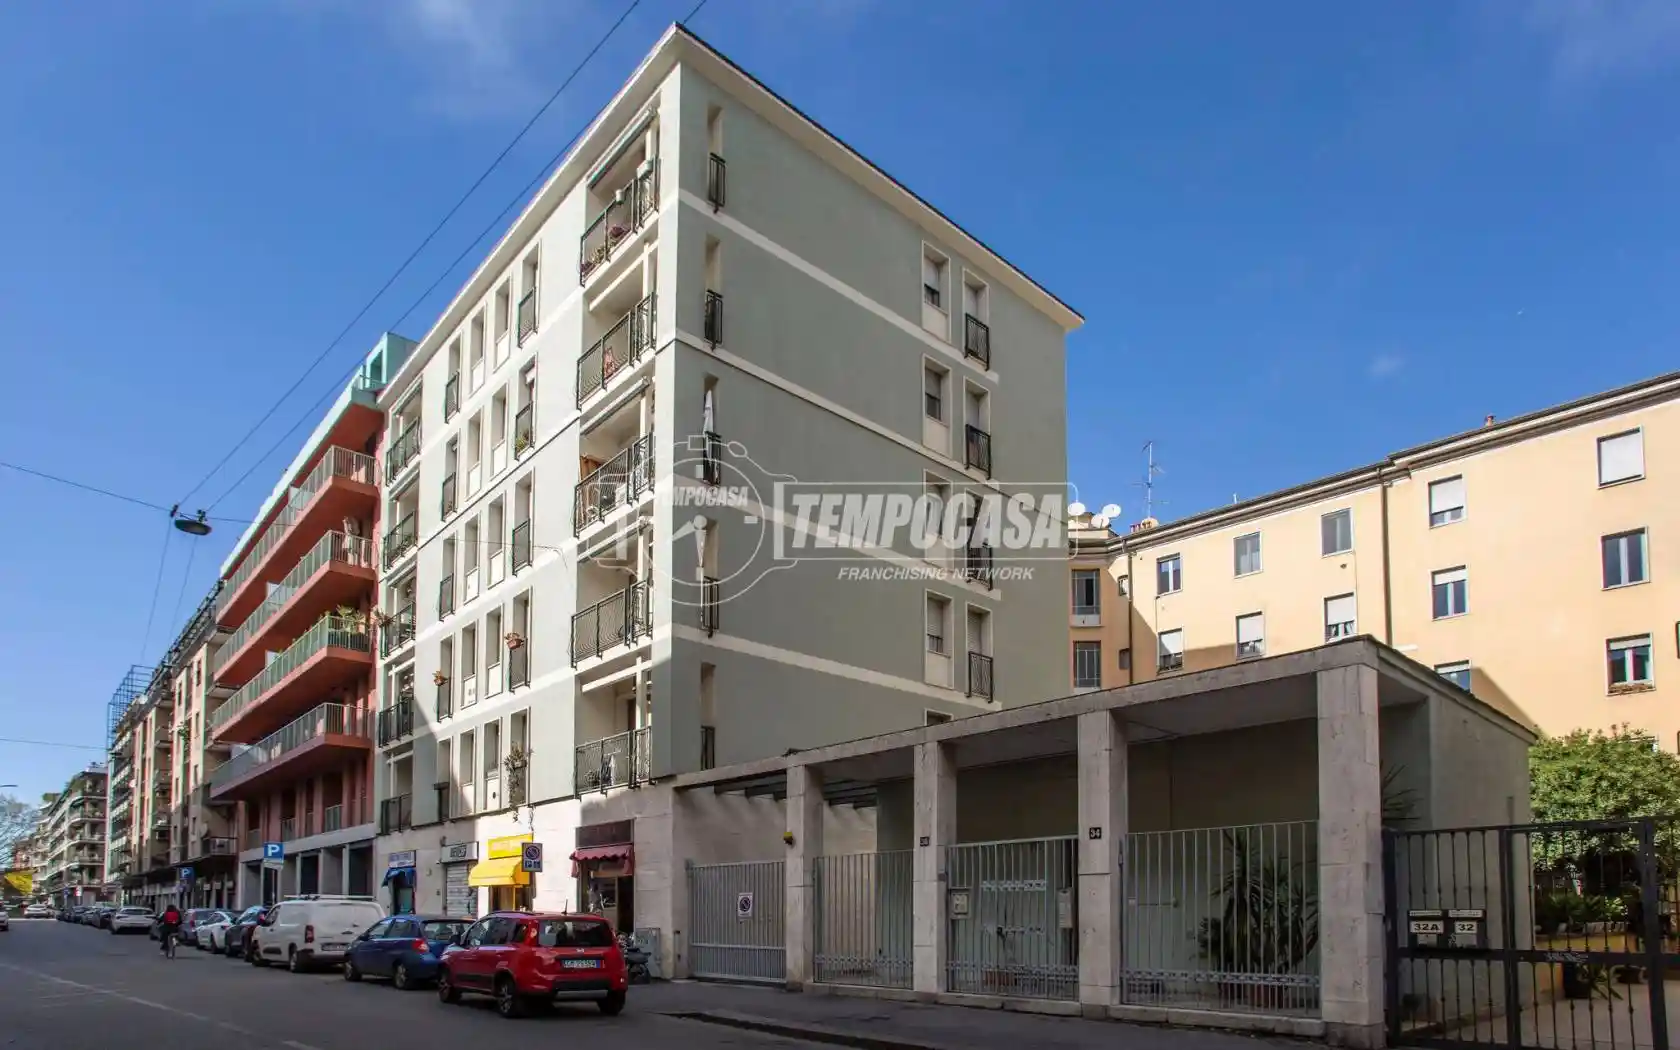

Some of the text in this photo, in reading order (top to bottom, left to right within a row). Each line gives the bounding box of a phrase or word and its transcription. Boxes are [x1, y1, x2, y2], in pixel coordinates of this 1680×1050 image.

[1090, 828, 1101, 839] 34
[267, 844, 280, 857] P
[182, 868, 190, 878] P
[1414, 923, 1440, 931] 32A
[1459, 923, 1474, 931] 32
